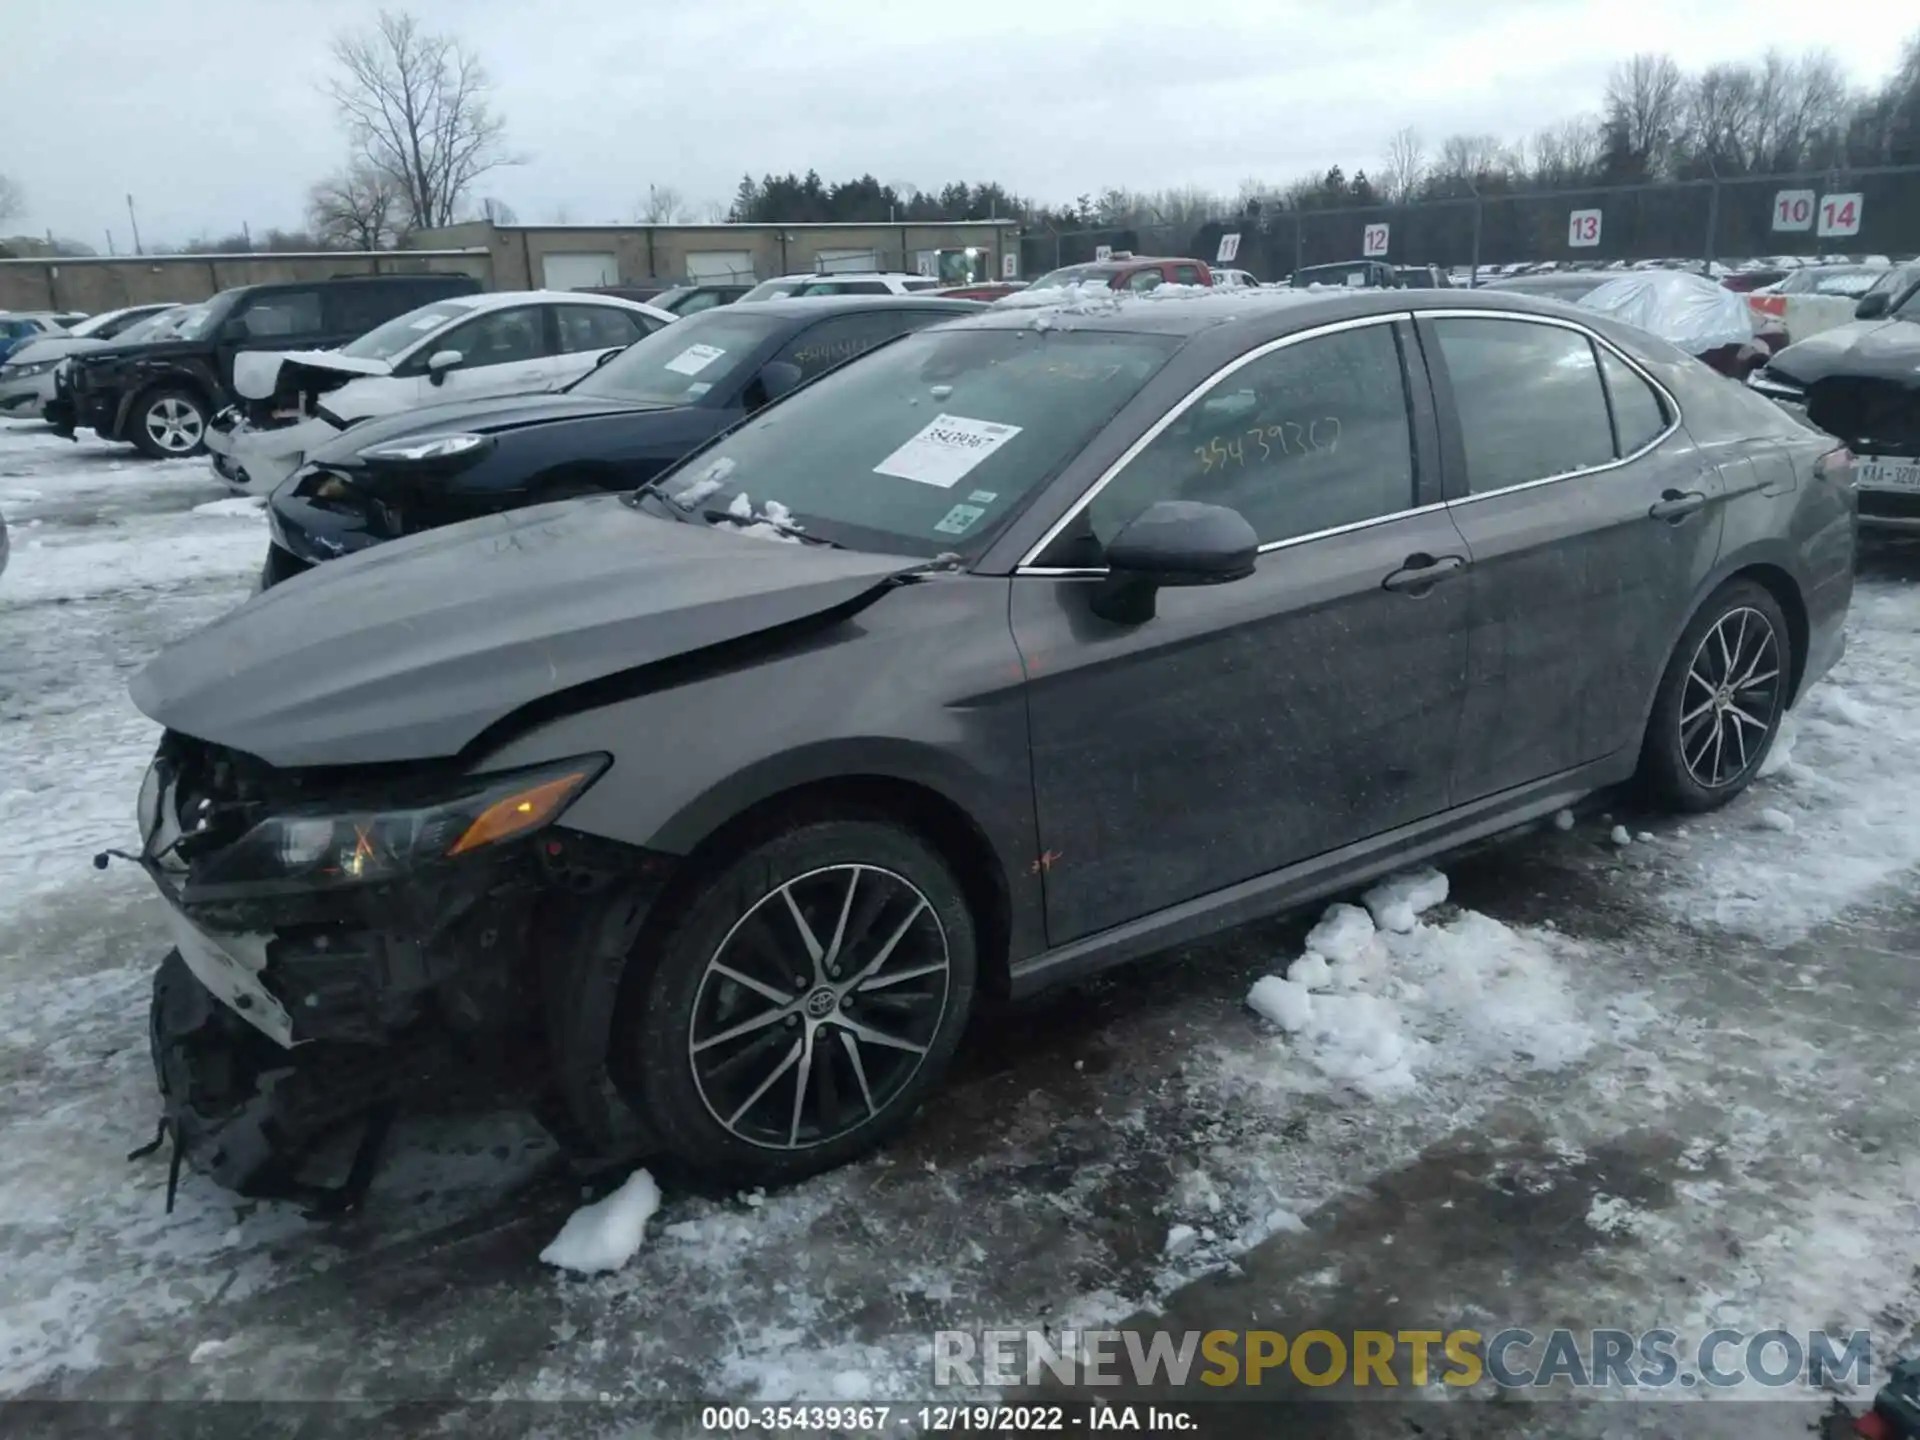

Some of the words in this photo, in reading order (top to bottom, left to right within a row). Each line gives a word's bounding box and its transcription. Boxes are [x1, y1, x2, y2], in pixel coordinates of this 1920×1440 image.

[1779, 199, 1809, 222] 10
[1824, 201, 1856, 228] 14
[1572, 216, 1598, 240] 13
[1222, 239, 1237, 257] 11
[1366, 230, 1386, 251] 12
